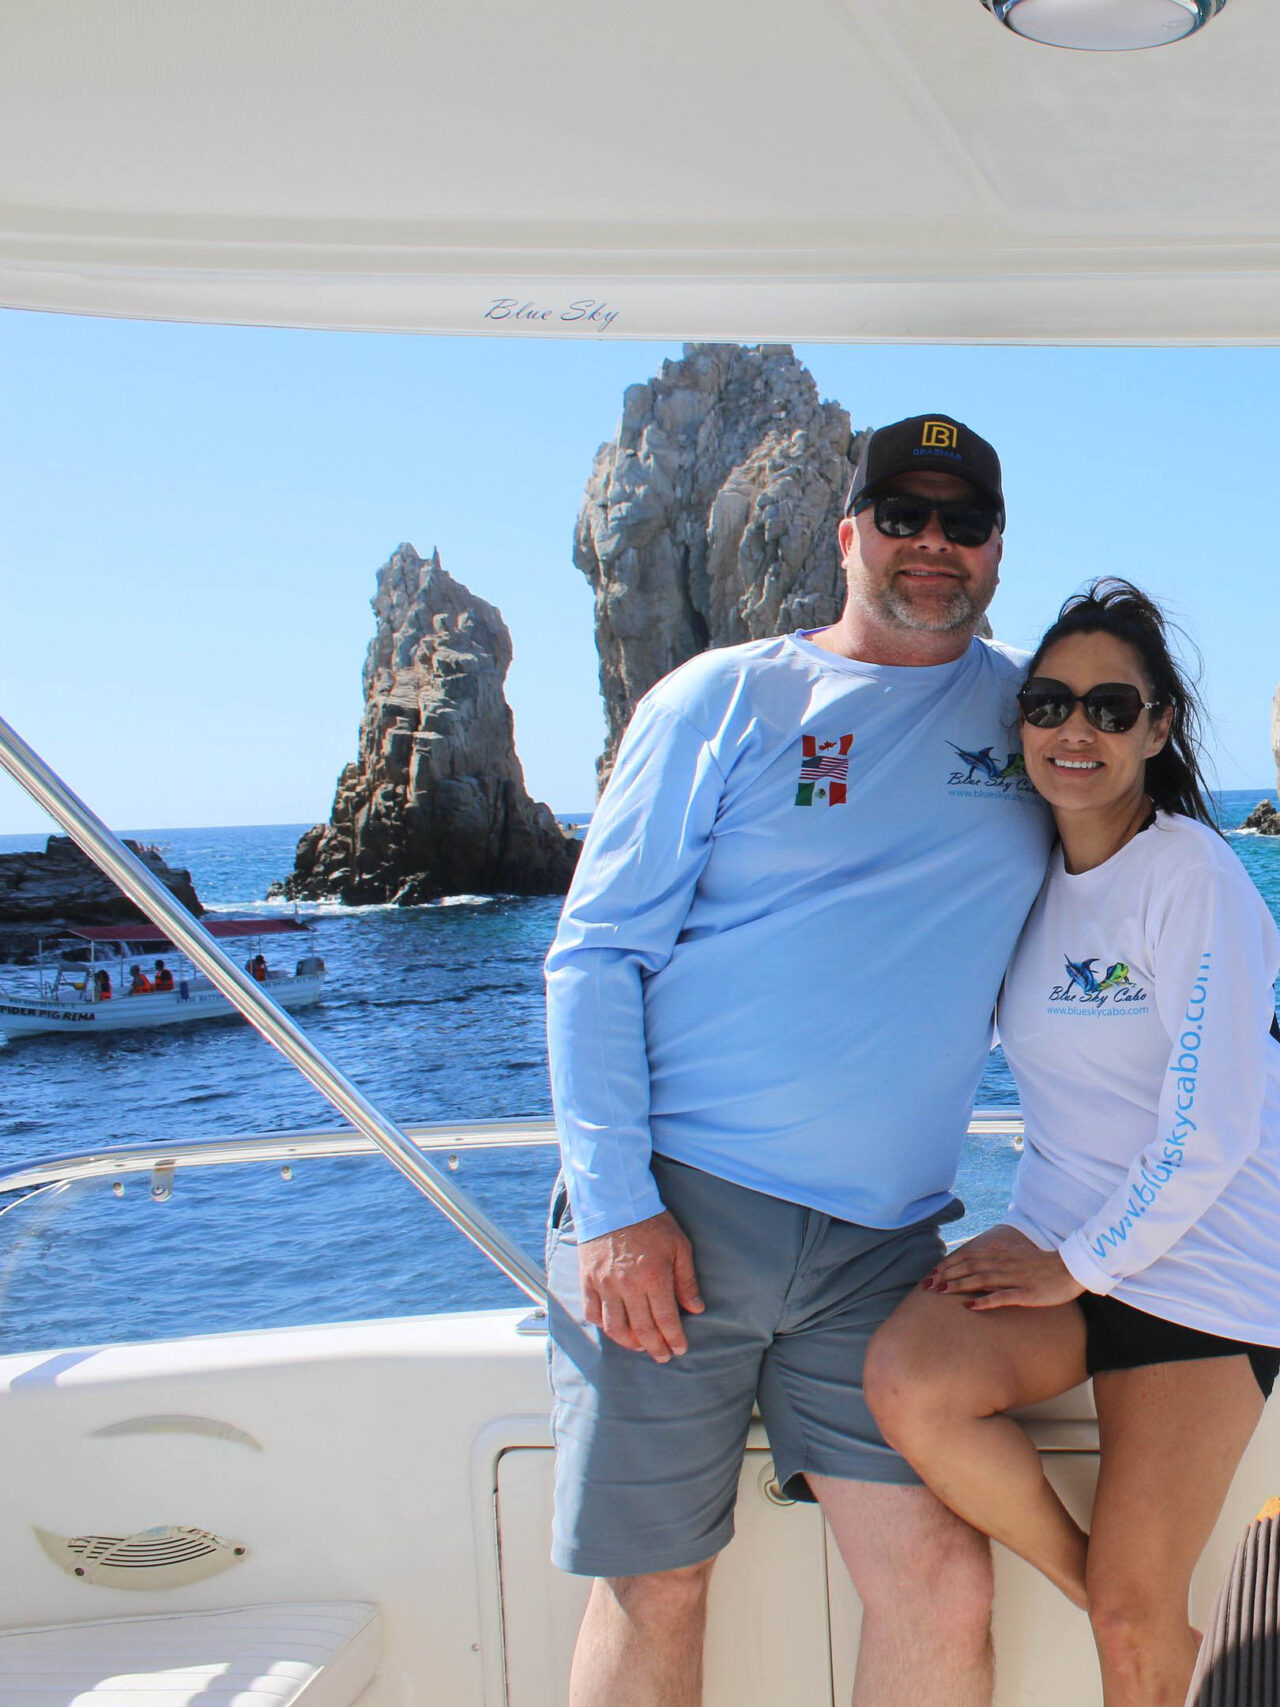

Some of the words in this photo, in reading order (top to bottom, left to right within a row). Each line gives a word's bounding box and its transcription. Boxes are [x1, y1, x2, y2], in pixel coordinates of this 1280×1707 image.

[484, 298, 553, 320] Blue
[560, 299, 620, 333] Sky
[946, 772, 980, 786] Blue
[1048, 985, 1077, 1001] Blue
[1080, 992, 1109, 1009] Sky
[1113, 987, 1148, 1003] Cabo
[0, 1004, 36, 1017] PIDER
[1046, 1006, 1149, 1018] www.blueskycabo.com
